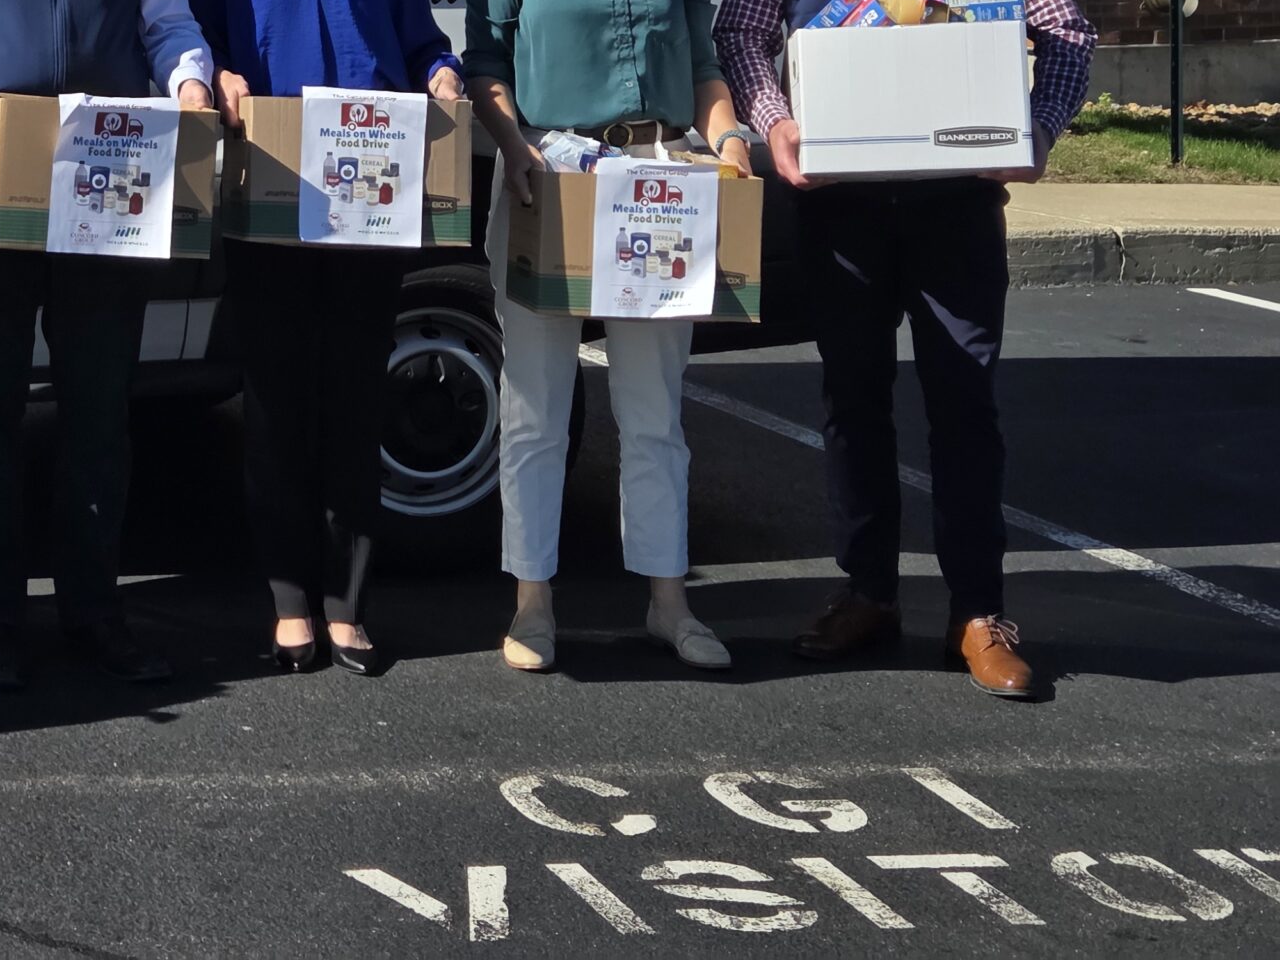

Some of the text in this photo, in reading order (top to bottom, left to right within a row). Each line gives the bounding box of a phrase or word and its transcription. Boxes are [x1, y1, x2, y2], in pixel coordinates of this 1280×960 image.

[320, 128, 351, 137] Meals
[369, 129, 406, 140] Wheels
[939, 132, 1013, 142] BANKERS BOX
[73, 136, 158, 149] Meals on Wheels
[336, 138, 390, 148] Food Drive
[88, 147, 142, 158] Food Drive
[361, 159, 384, 167] CEREAL
[613, 204, 644, 213] Meals
[661, 205, 699, 215] Wheels
[628, 214, 682, 224] Food Drive
